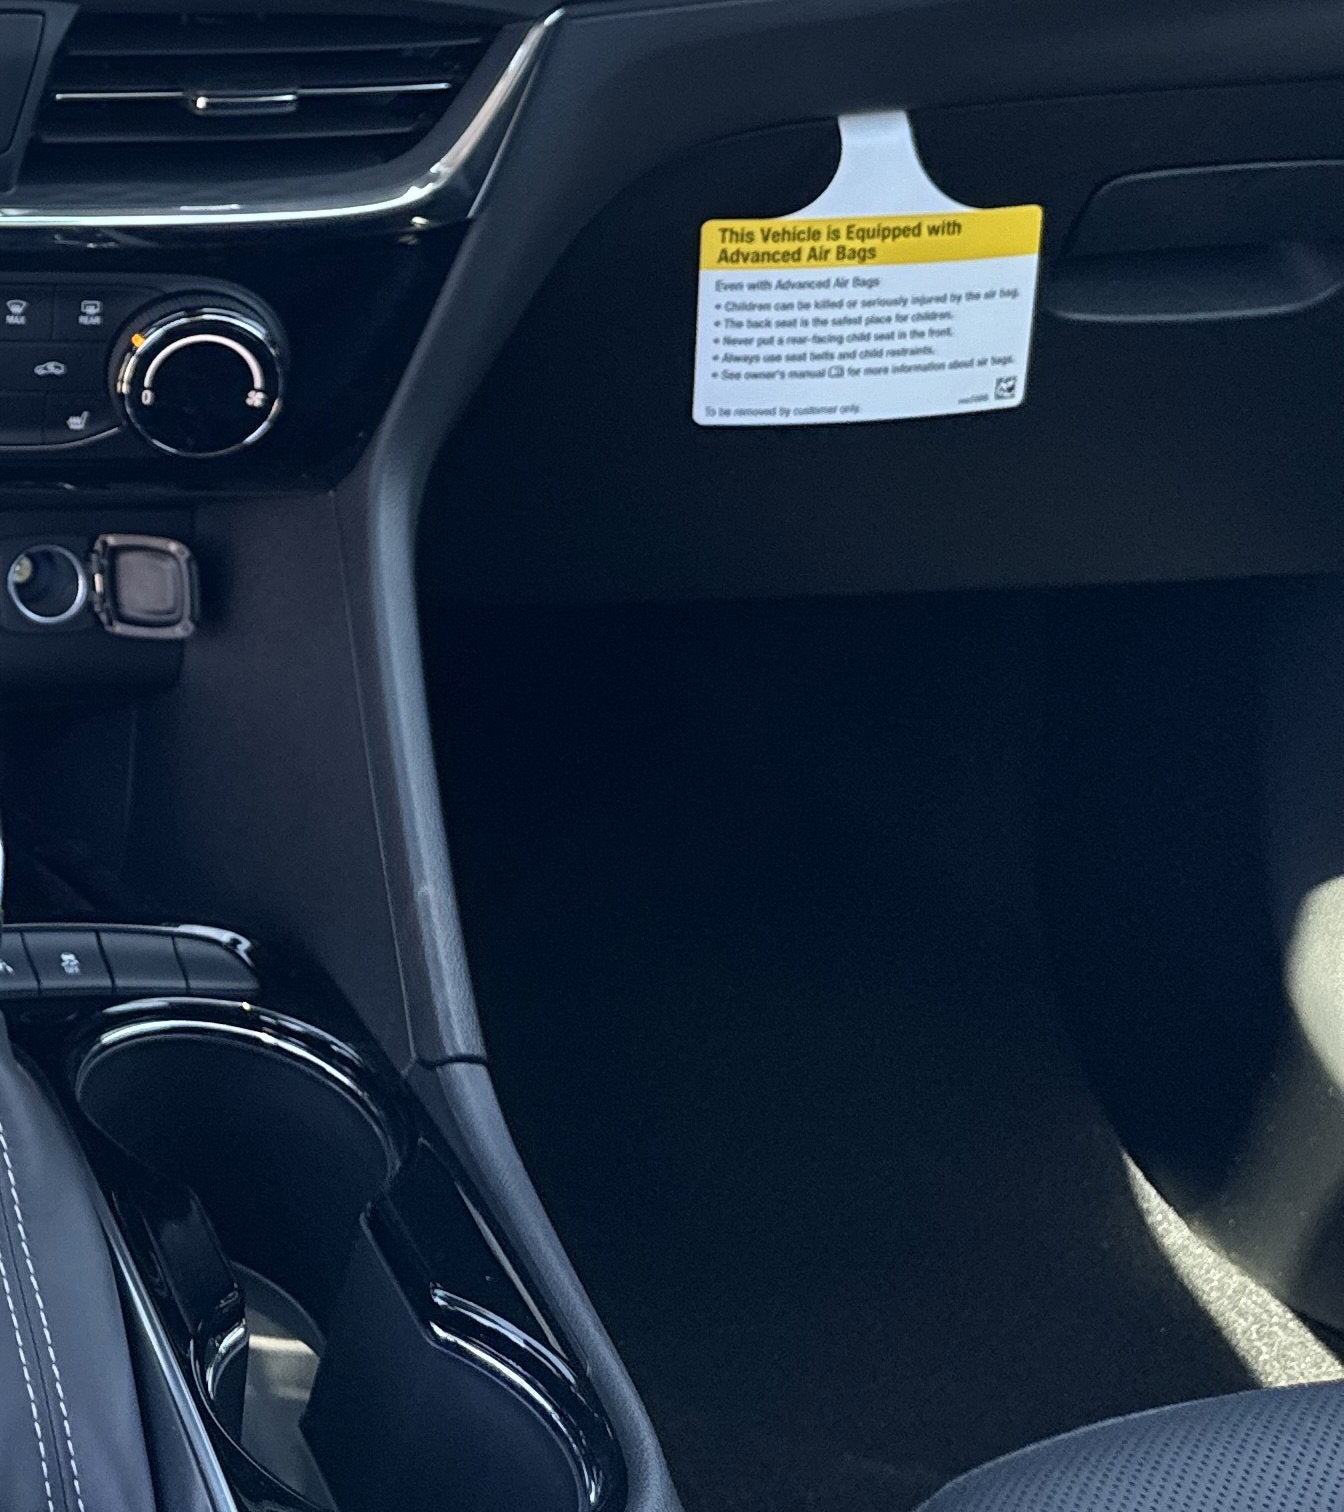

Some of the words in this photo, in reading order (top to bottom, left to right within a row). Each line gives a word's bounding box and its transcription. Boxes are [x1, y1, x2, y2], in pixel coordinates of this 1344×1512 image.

[719, 227, 755, 244] This
[760, 226, 821, 243] Vehicle
[827, 224, 840, 241] is
[846, 221, 922, 243] Equipped
[927, 219, 962, 237] with
[717, 247, 802, 264] Advanced
[806, 245, 831, 263] Air
[836, 244, 877, 264] Bags
[714, 279, 745, 292] Even
[747, 279, 772, 291] with
[775, 277, 830, 291] Advanced
[833, 276, 849, 288] Air
[852, 275, 880, 289] Bags
[724, 300, 771, 312] Children
[774, 302, 794, 312] can
[797, 300, 811, 311] be
[814, 298, 844, 309] killed
[846, 299, 857, 308] or
[861, 296, 909, 307] seriously
[911, 293, 948, 306] injured
[950, 293, 962, 304] by
[965, 291, 981, 302] the
[724, 318, 744, 329] The
[746, 318, 772, 329] back
[774, 318, 797, 329] seat
[812, 316, 829, 327] the
[864, 314, 892, 326] place
[895, 312, 909, 323] for
[846, 331, 871, 343] child
[873, 330, 895, 341] seat
[910, 328, 925, 339] the
[721, 353, 761, 365] Always
[785, 352, 807, 363] seat
[809, 351, 834, 362] belts
[837, 349, 857, 360] and
[859, 348, 883, 360] child
[721, 369, 742, 380] See
[847, 366, 861, 376] for
[863, 366, 889, 375] more
[891, 362, 946, 373] information
